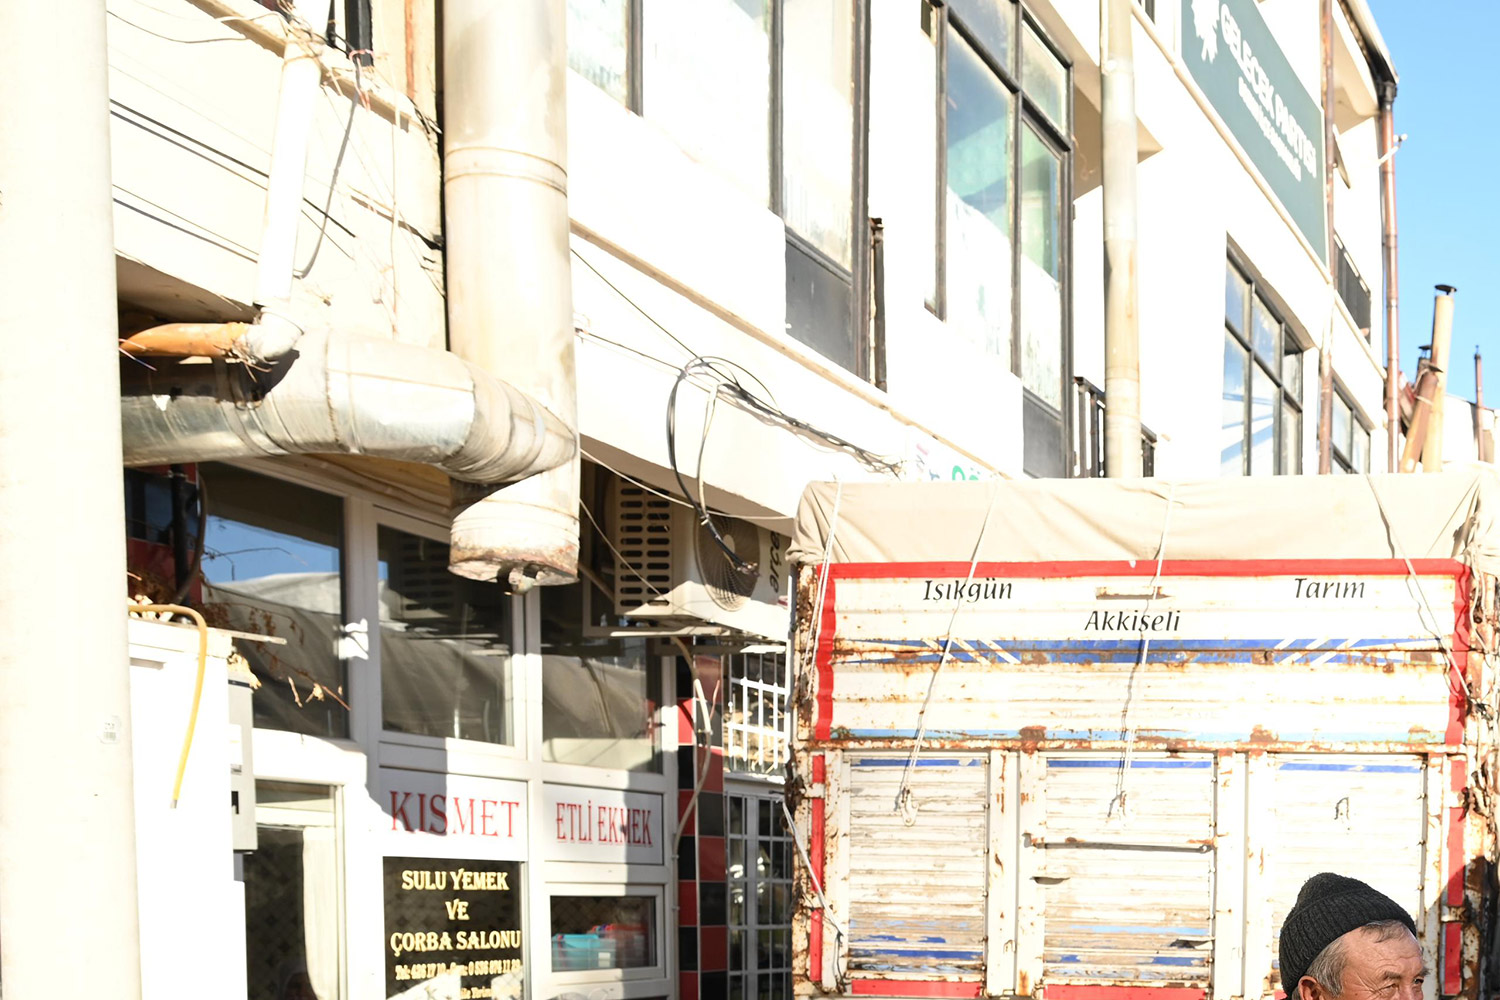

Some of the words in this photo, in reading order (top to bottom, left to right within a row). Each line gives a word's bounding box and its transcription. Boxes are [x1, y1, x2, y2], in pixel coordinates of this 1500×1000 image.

[1221, 3, 1275, 119] GELECEK
[1294, 577, 1366, 599] Tarım
[389, 790, 520, 838] KISMET
[556, 800, 592, 843] ETLİ
[598, 806, 652, 846] EKMEK
[401, 870, 447, 890] SULU
[450, 868, 510, 890] YEMEK
[445, 898, 470, 920] VE
[390, 931, 453, 957] ÇORBA
[456, 930, 521, 950] SALONU
